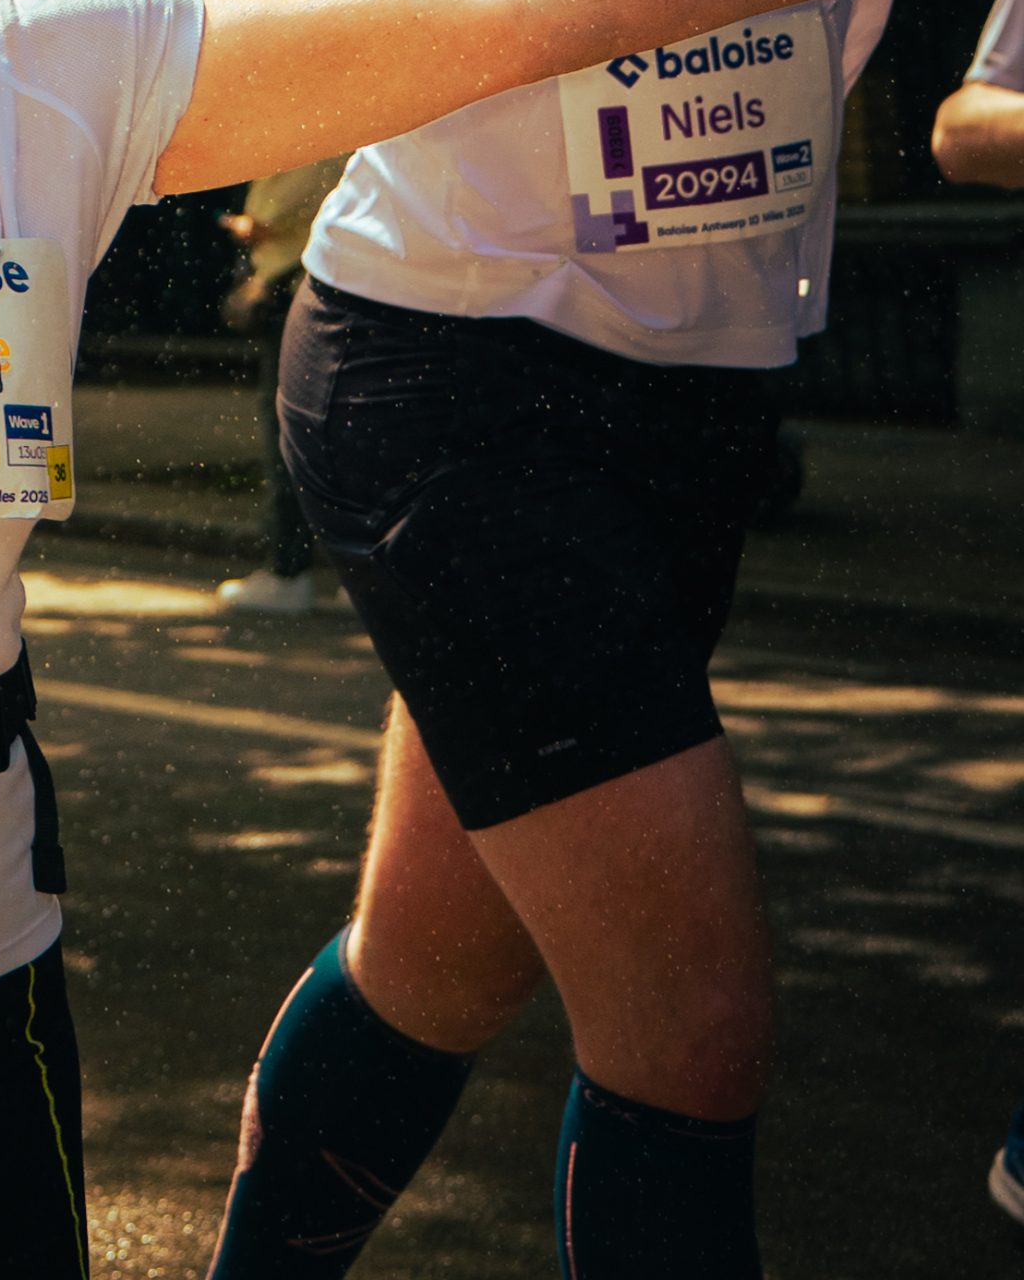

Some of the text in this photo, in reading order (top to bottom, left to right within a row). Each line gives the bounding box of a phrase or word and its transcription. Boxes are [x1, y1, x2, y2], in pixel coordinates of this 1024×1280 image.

[655, 27, 794, 80] baloise
[661, 91, 766, 141] Niels
[800, 145, 809, 163] 2
[654, 162, 759, 202] 20994
[657, 223, 697, 237] Baloise
[701, 218, 746, 233] Antwerp
[8, 412, 50, 435] Wave 1
